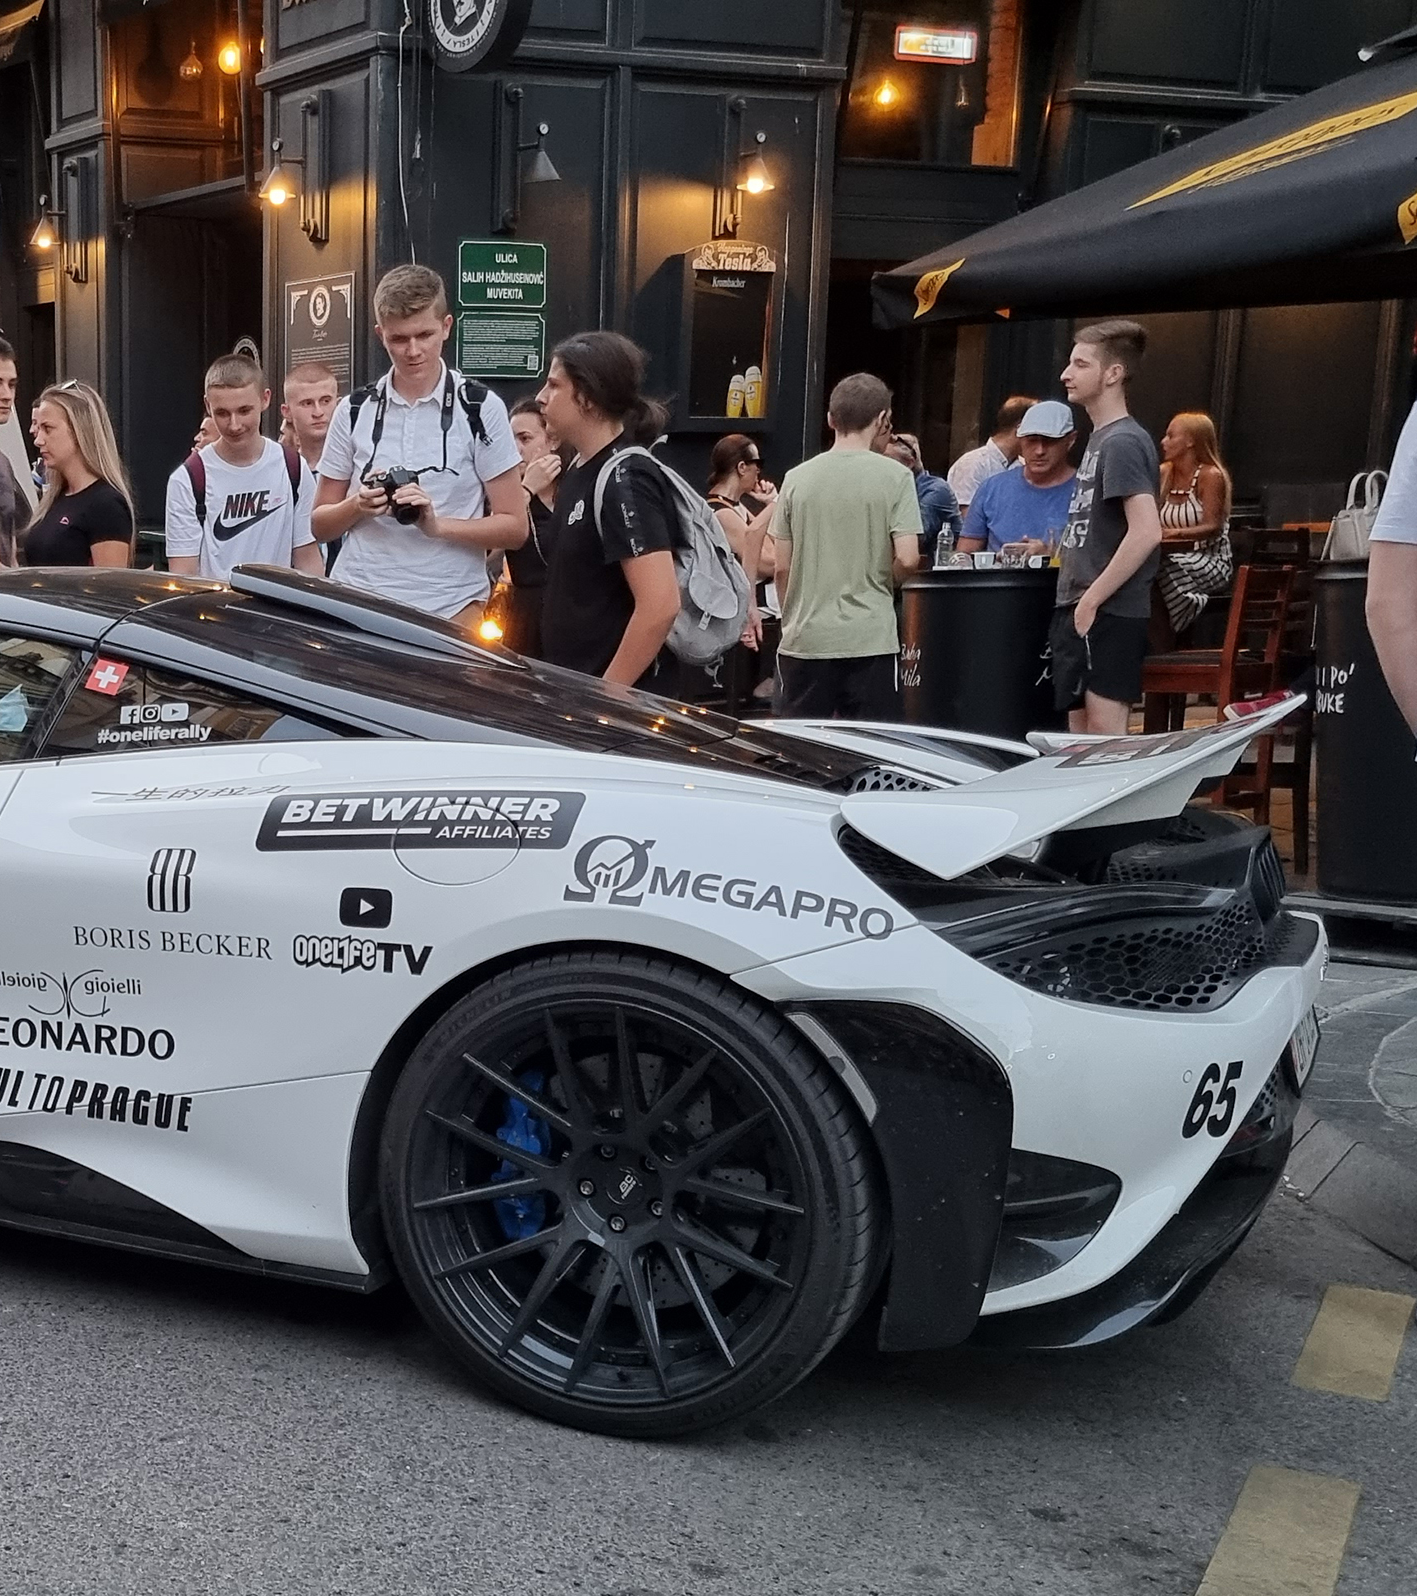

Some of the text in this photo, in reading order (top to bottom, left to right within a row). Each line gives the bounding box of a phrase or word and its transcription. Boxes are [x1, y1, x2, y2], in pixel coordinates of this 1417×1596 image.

[495, 253, 518, 264] ULICA
[462, 271, 484, 283] SALIH
[487, 288, 524, 300] MUVEKITA
[223, 490, 270, 521] NIKE
[97, 724, 212, 745] #oneliferally
[280, 797, 561, 825] BETWINNER
[435, 826, 553, 841] AFFILIATES
[73, 925, 273, 961] BORIS BECKER
[84, 975, 142, 996] gioielli
[1181, 1060, 1244, 1139] 65
